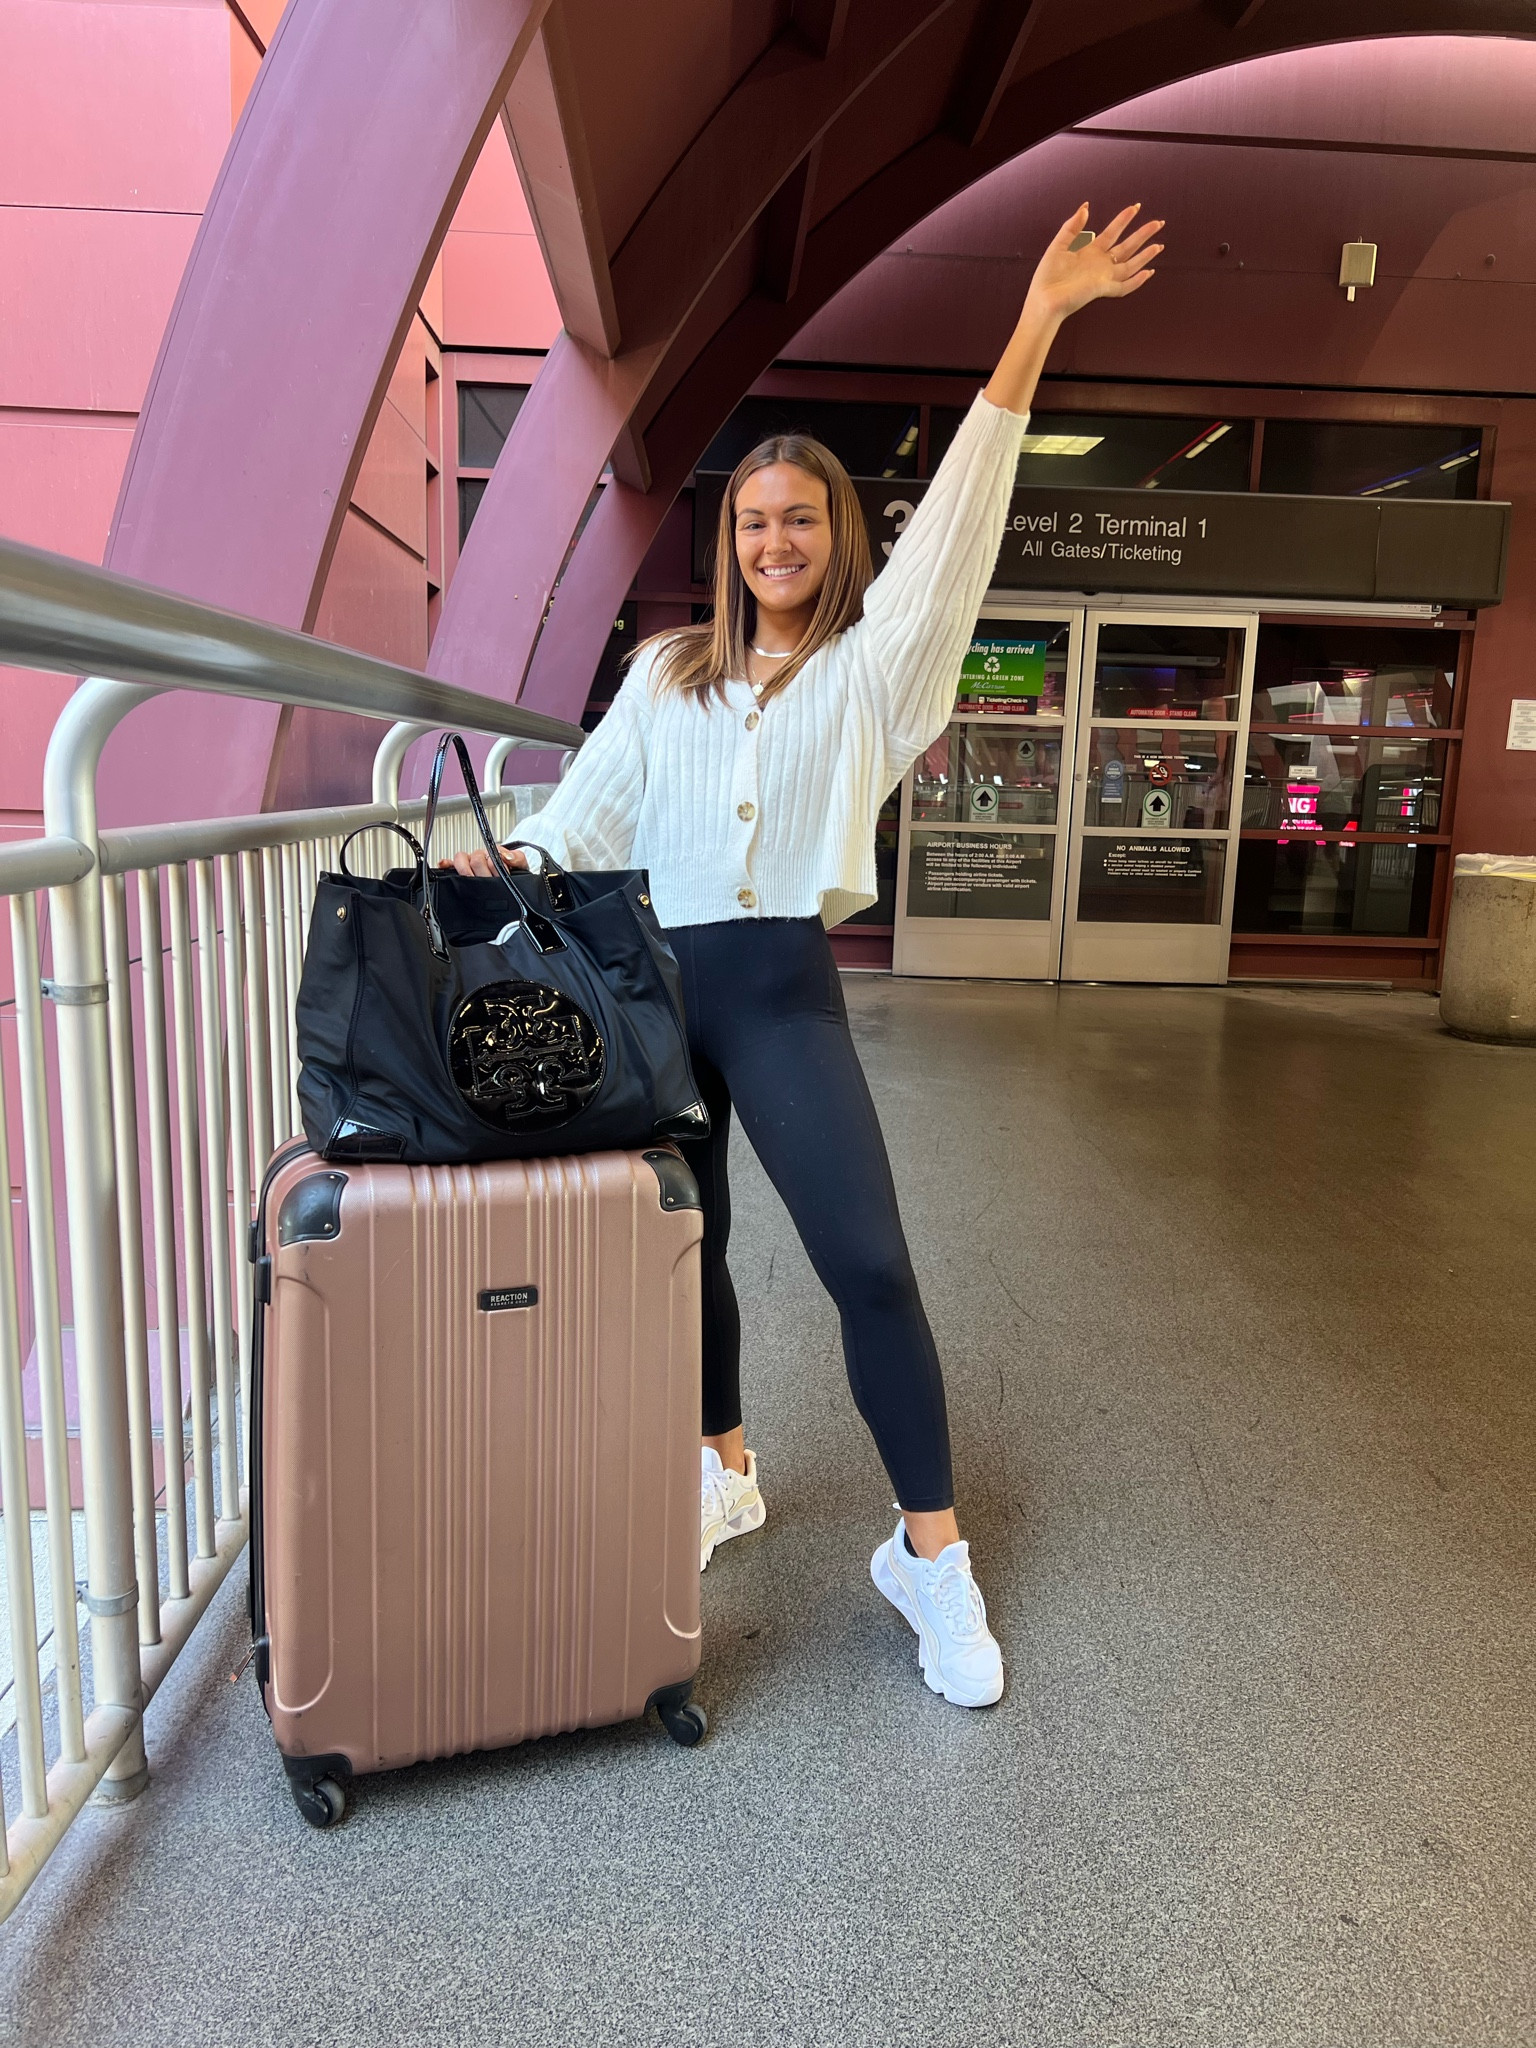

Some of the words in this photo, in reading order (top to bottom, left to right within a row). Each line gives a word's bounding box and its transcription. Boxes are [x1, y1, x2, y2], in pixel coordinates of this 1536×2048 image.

[1069, 512, 1083, 534] 2
[1095, 513, 1188, 538] Terminal
[1198, 518, 1207, 539] 1
[1021, 540, 1043, 557] All
[1051, 541, 1182, 566] Gates/Ticketing
[990, 642, 1005, 654] has
[1006, 643, 1035, 655] arrived
[926, 841, 955, 849] AIRPORT
[956, 842, 988, 850] BUSINESS
[1116, 844, 1126, 852] NO
[1128, 844, 1157, 852] ANIMALS
[1159, 845, 1191, 853] ALLOWED
[490, 1292, 528, 1303] REACTION
